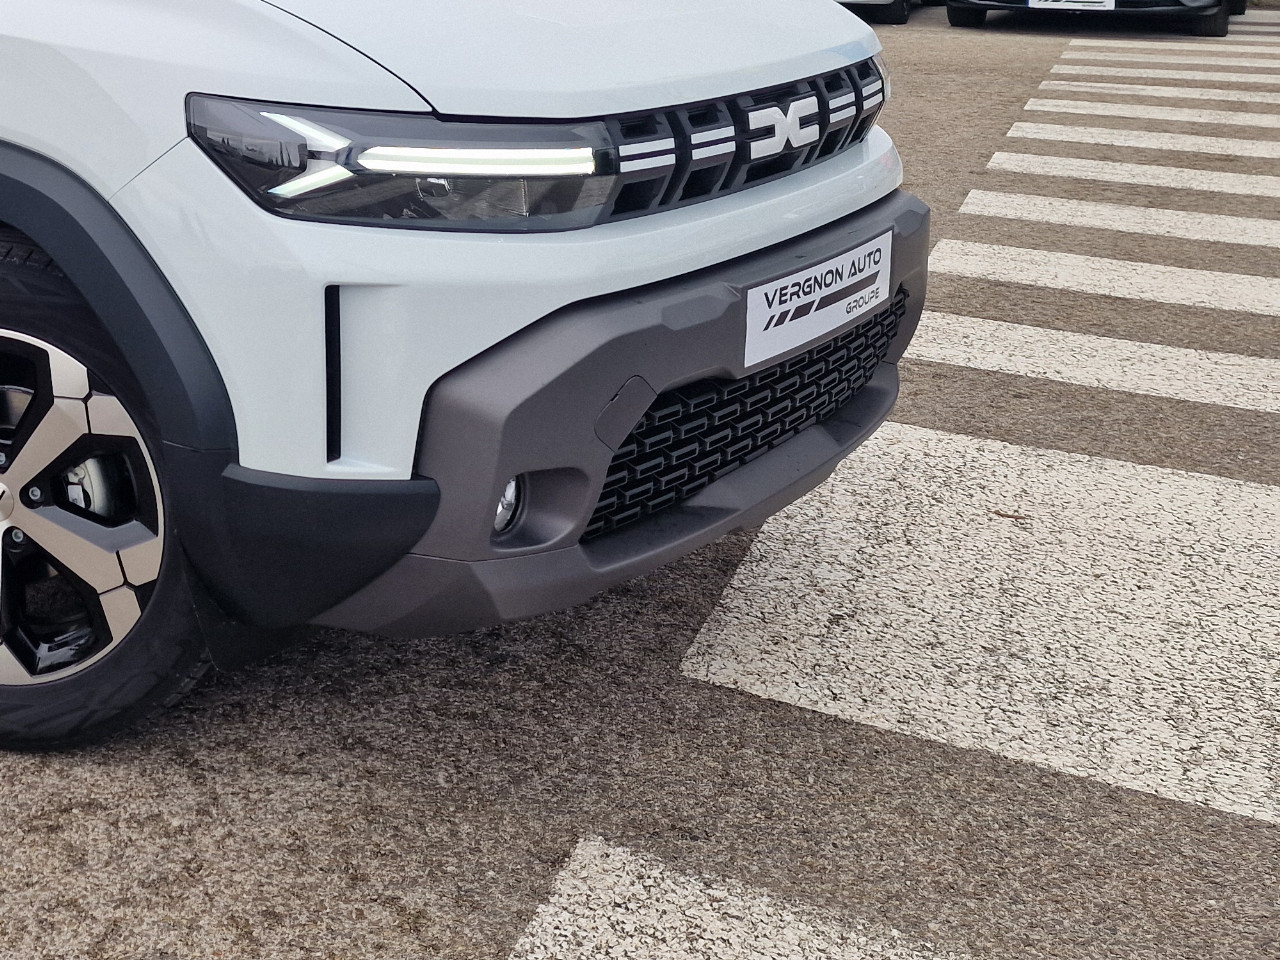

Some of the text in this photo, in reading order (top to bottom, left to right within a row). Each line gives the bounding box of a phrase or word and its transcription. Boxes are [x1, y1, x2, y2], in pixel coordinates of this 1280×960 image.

[764, 247, 882, 310] VERGNON AUTO
[845, 287, 880, 315] GROUPE
